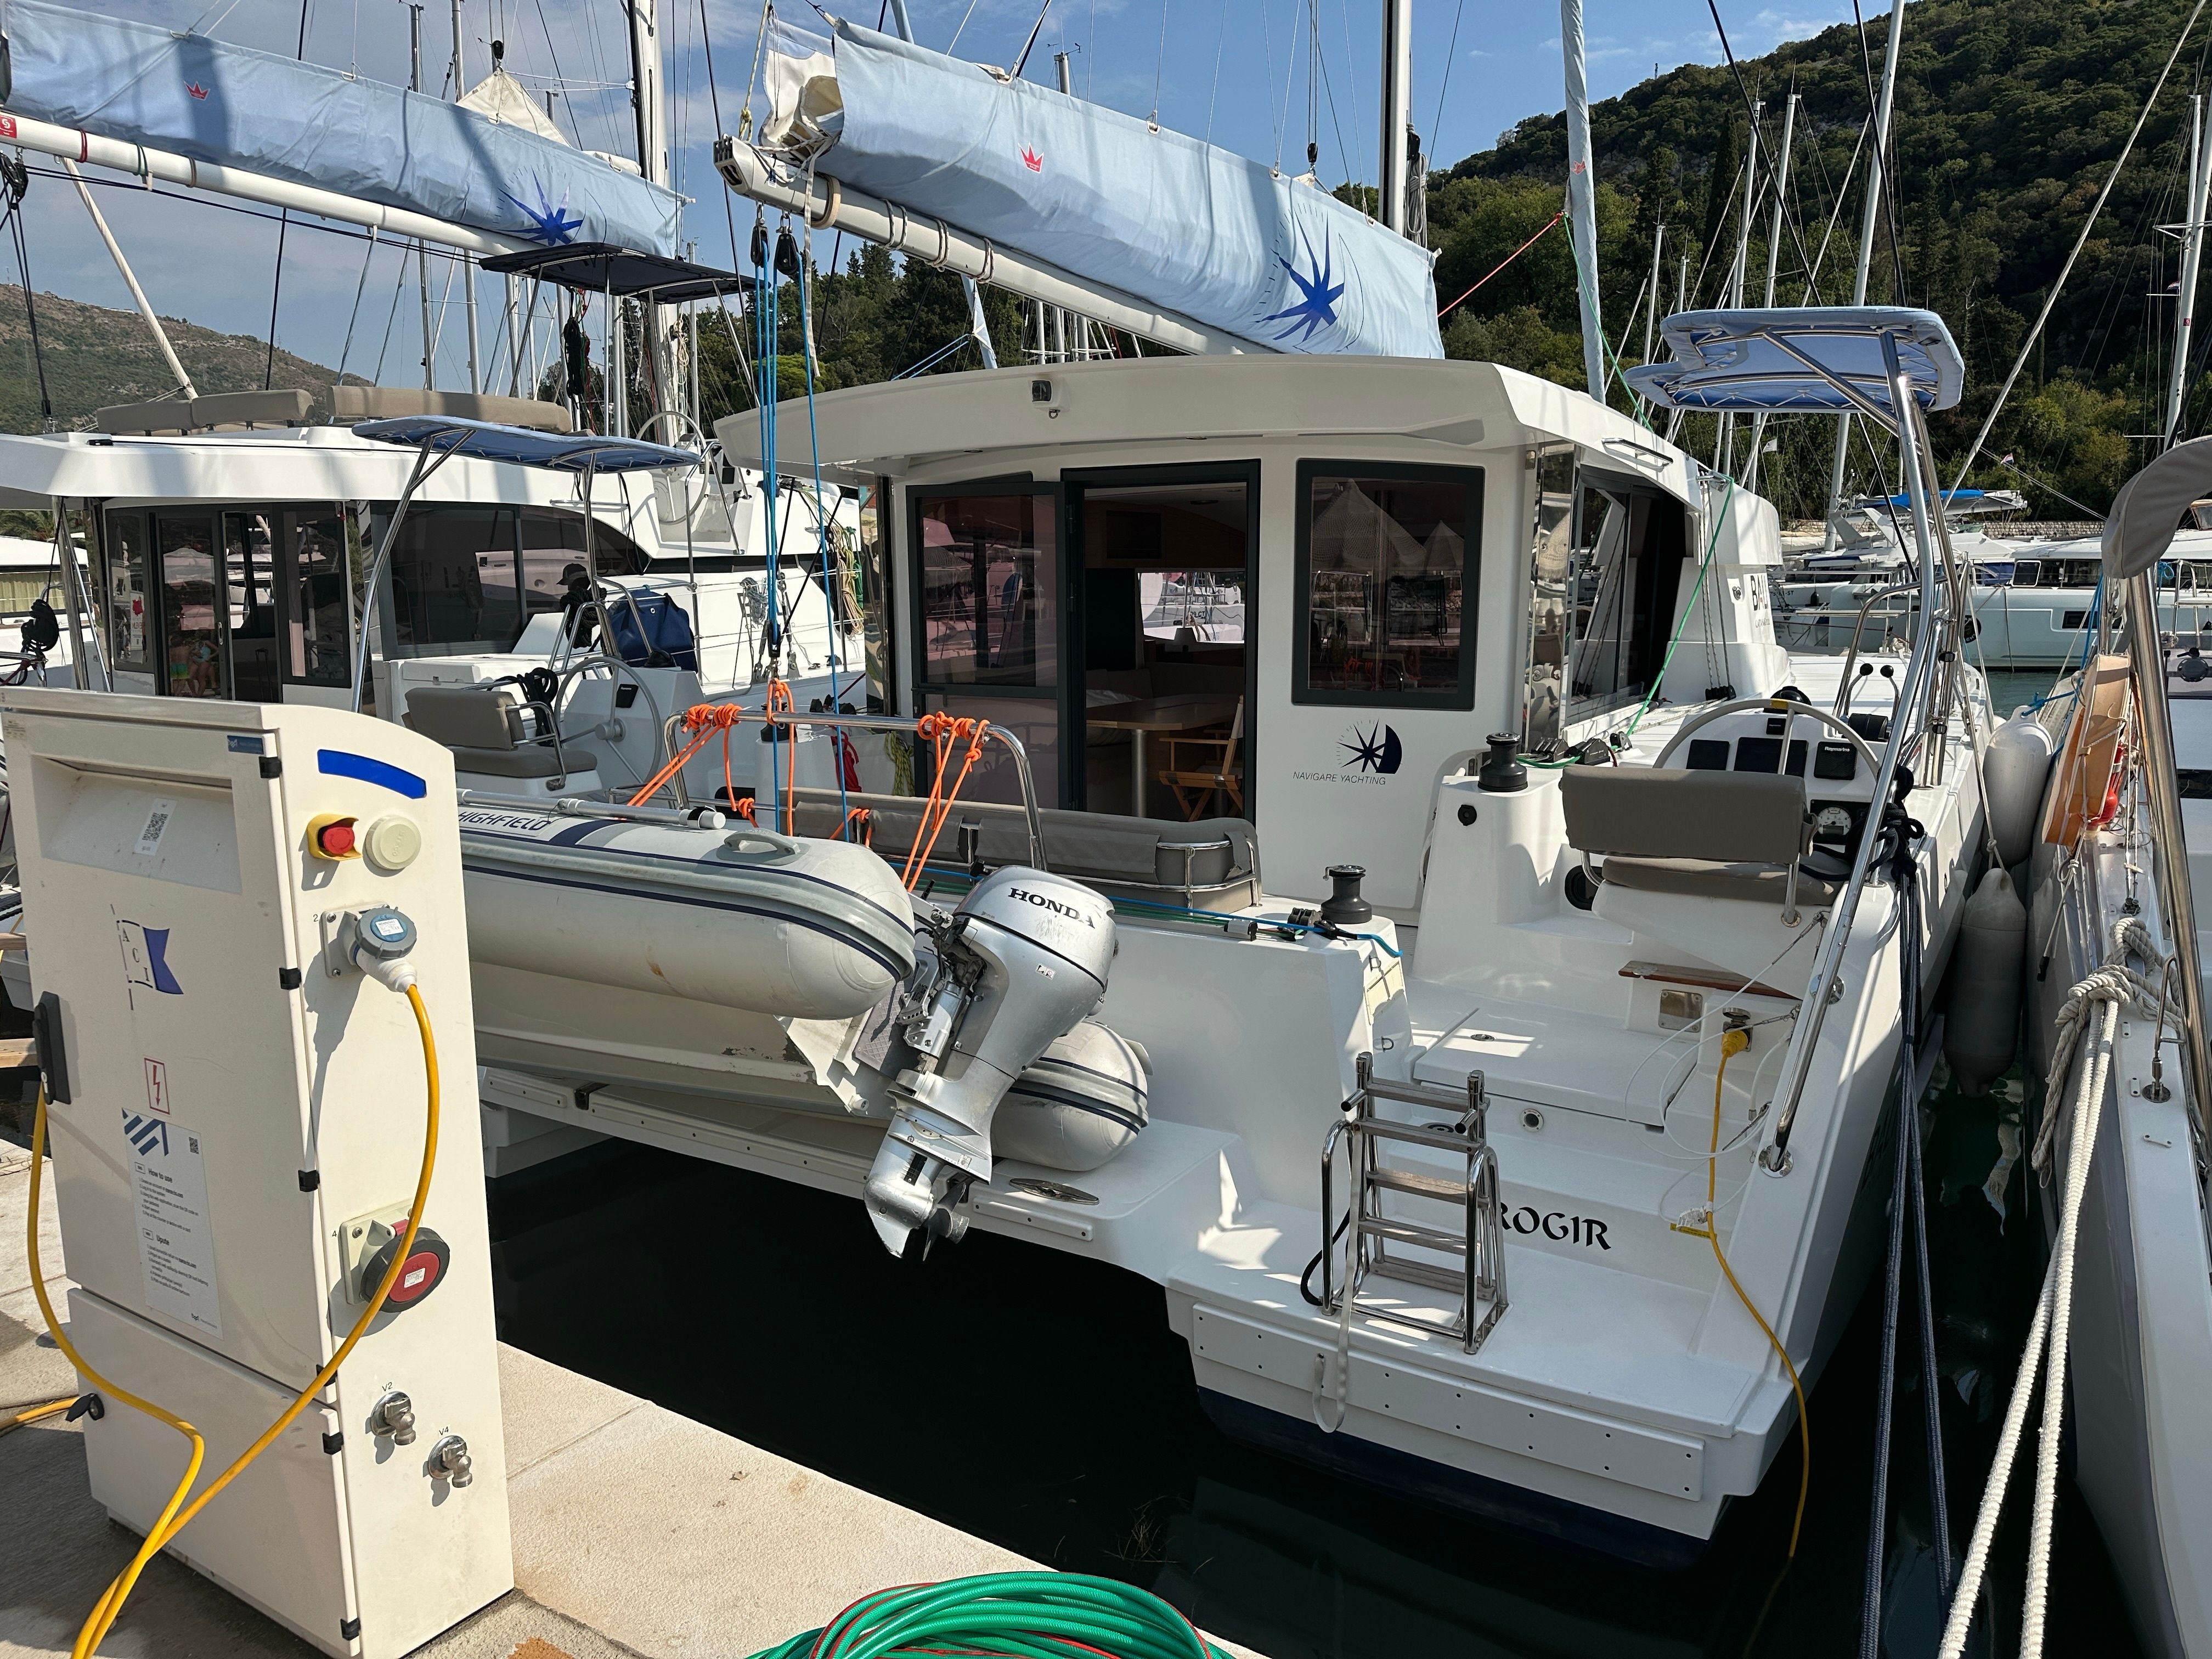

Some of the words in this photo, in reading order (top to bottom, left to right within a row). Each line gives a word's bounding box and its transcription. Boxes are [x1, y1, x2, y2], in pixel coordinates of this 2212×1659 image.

[1293, 771, 1338, 782] NAVIGARE
[1340, 774, 1386, 786] YACHTING
[458, 811, 551, 831] HIGHFIELD
[1008, 887, 1096, 929] HONDA
[382, 1381, 393, 1392] V2
[439, 1426, 449, 1435] V4
